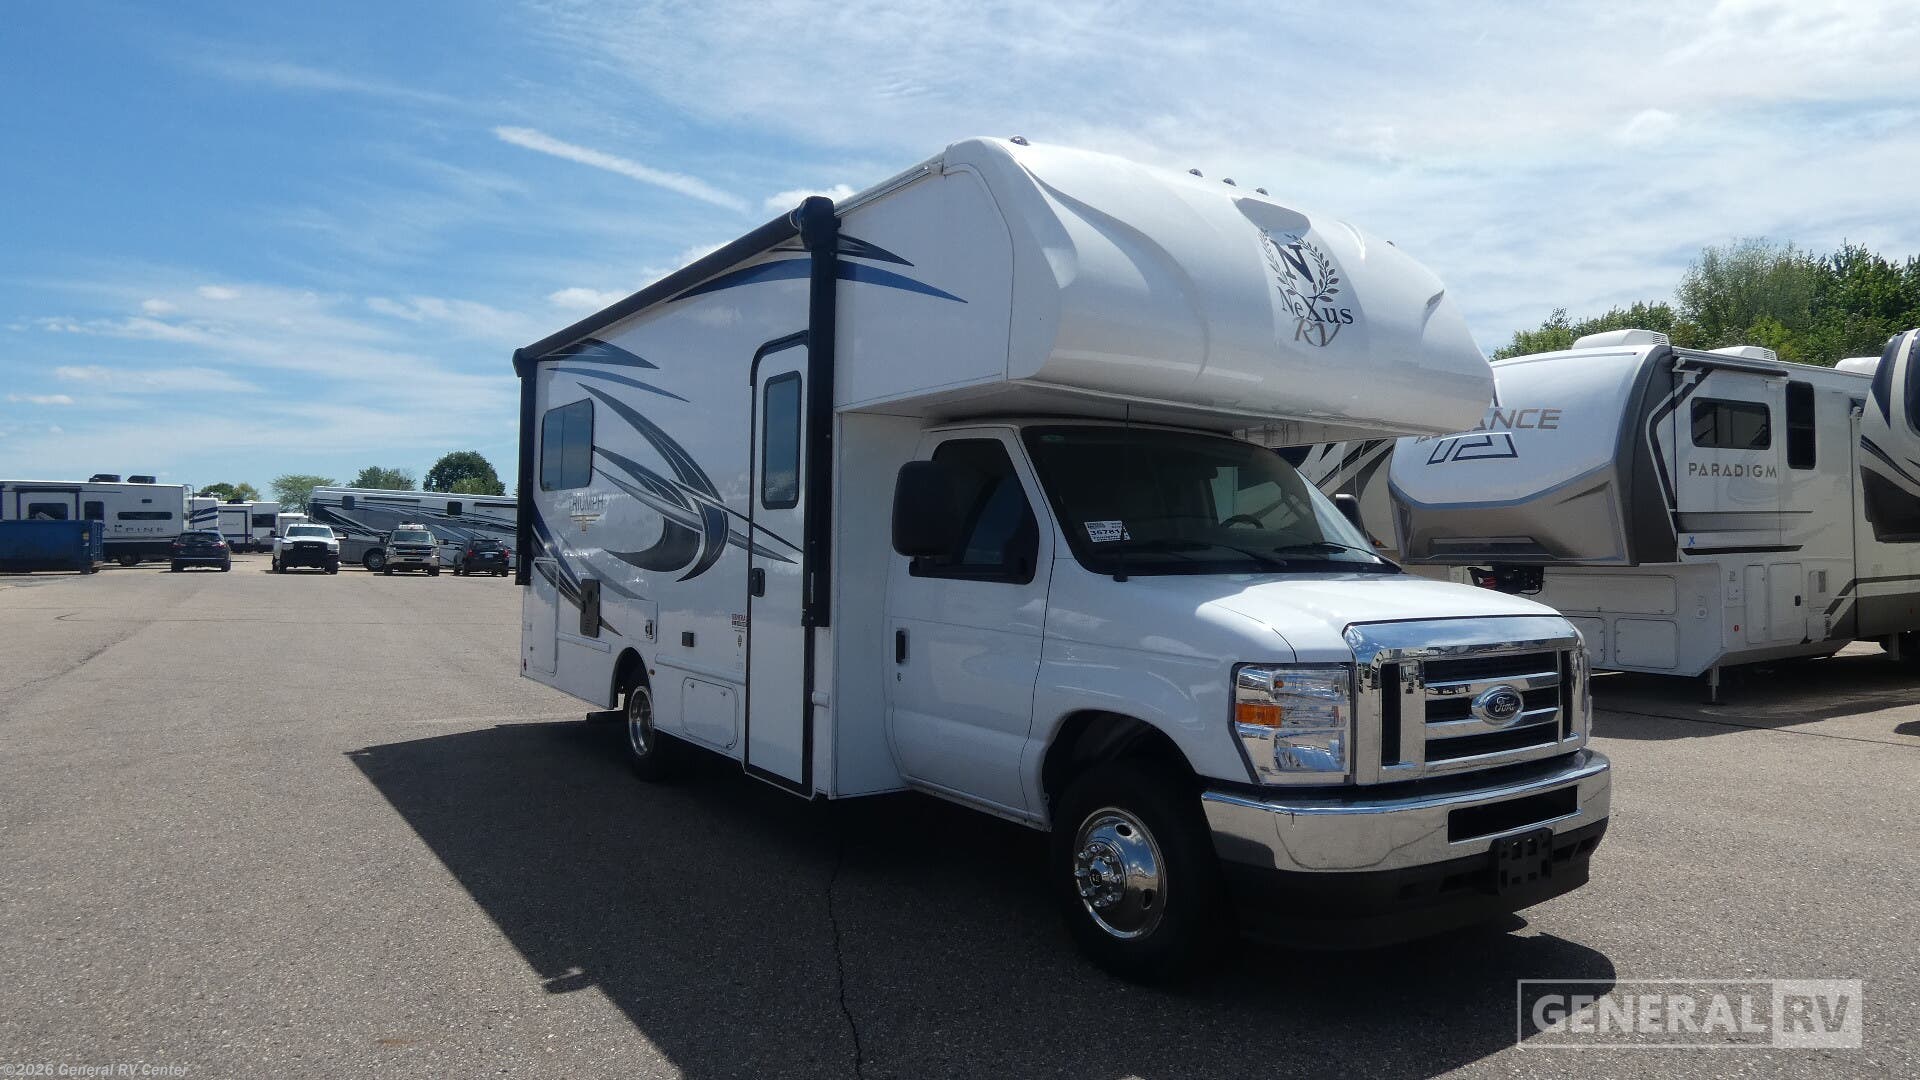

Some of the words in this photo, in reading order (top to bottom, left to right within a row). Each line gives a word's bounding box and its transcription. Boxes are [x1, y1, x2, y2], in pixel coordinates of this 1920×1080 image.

[1269, 239, 1315, 283] N
[1294, 319, 1341, 347] RV
[1688, 462, 1778, 478] PARADIGM
[1494, 696, 1516, 713] Ford
